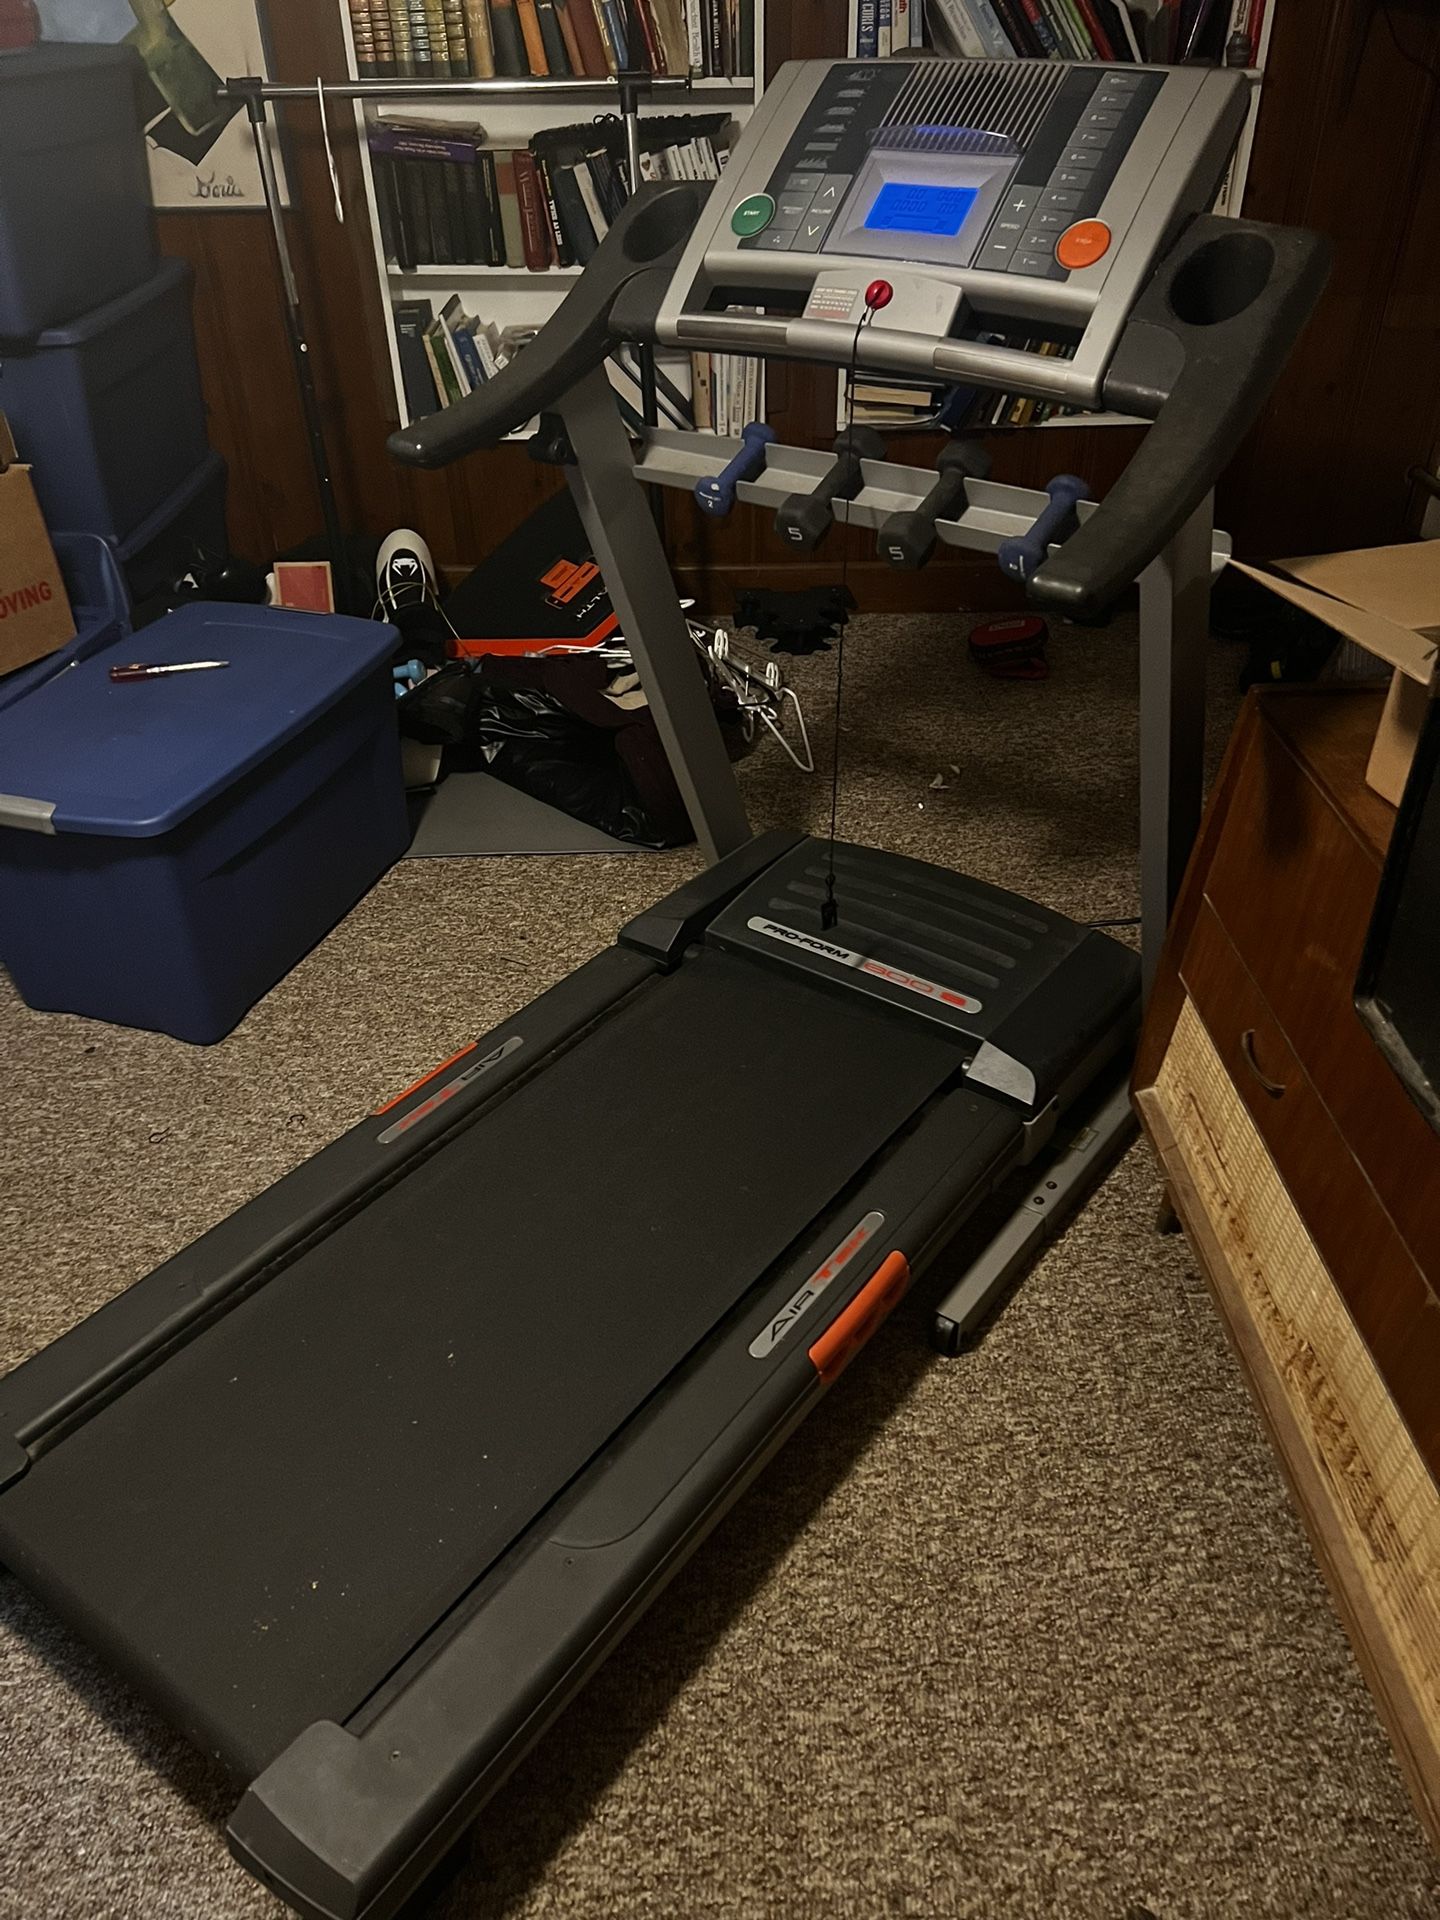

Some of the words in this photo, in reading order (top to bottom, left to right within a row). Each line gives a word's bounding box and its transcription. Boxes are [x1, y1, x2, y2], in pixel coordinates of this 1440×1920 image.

[788, 527, 803, 540] 5
[889, 546, 904, 560] 5
[0, 581, 52, 619] OVING
[763, 923, 850, 960] PRO-FORM
[771, 1289, 815, 1342] AIR
